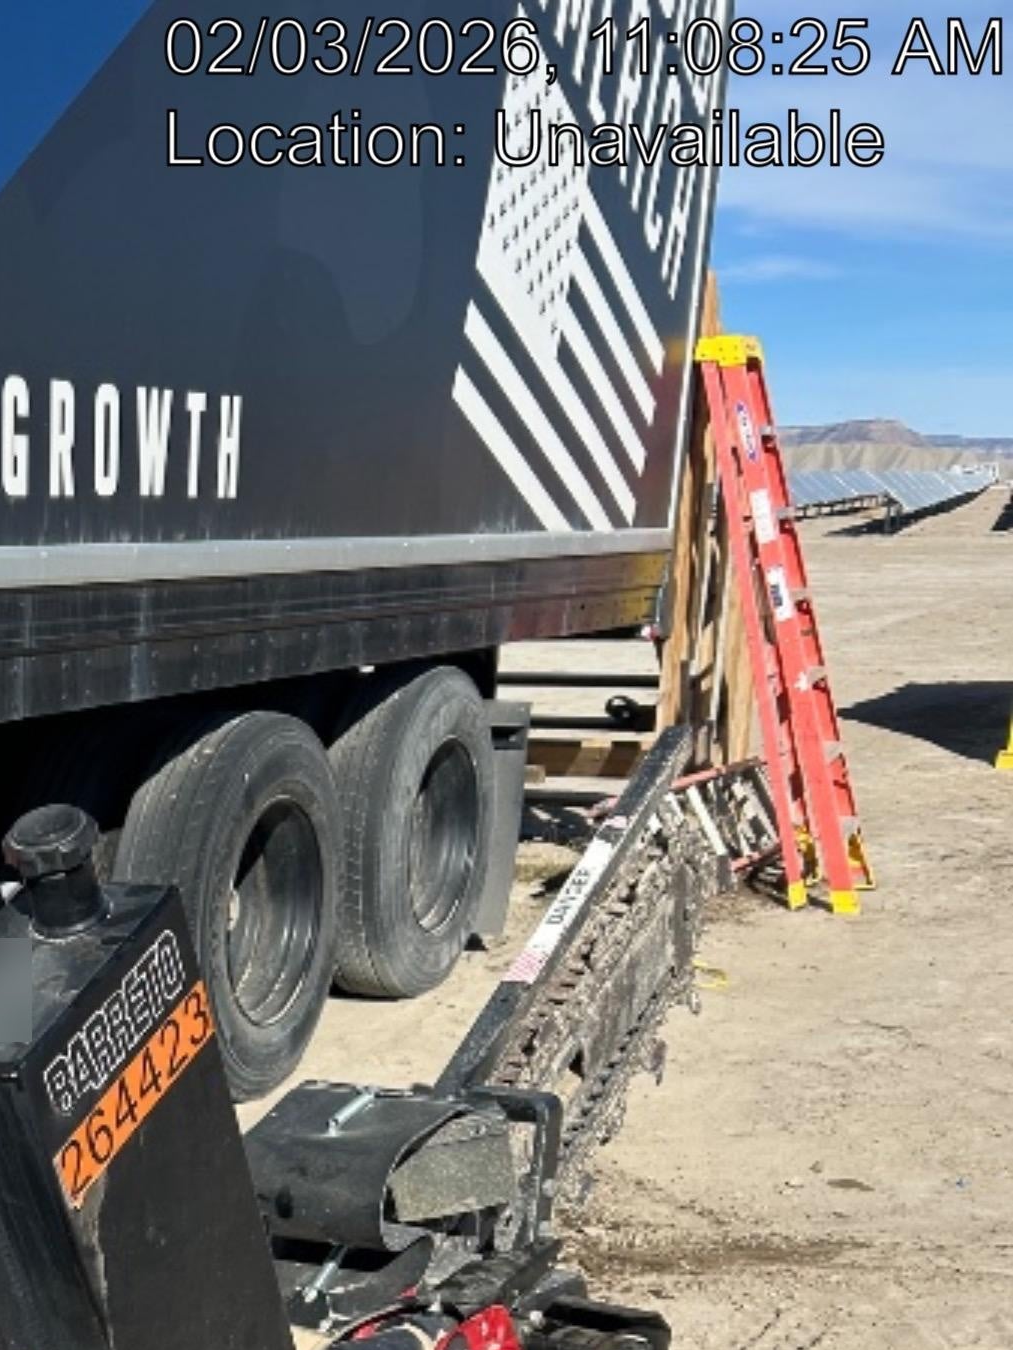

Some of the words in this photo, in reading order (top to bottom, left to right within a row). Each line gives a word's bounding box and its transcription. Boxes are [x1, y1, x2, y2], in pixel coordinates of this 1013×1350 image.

[0, 373, 243, 499] GROWTH
[43, 929, 186, 1117] BARRETO
[60, 990, 211, 1200] 264423
